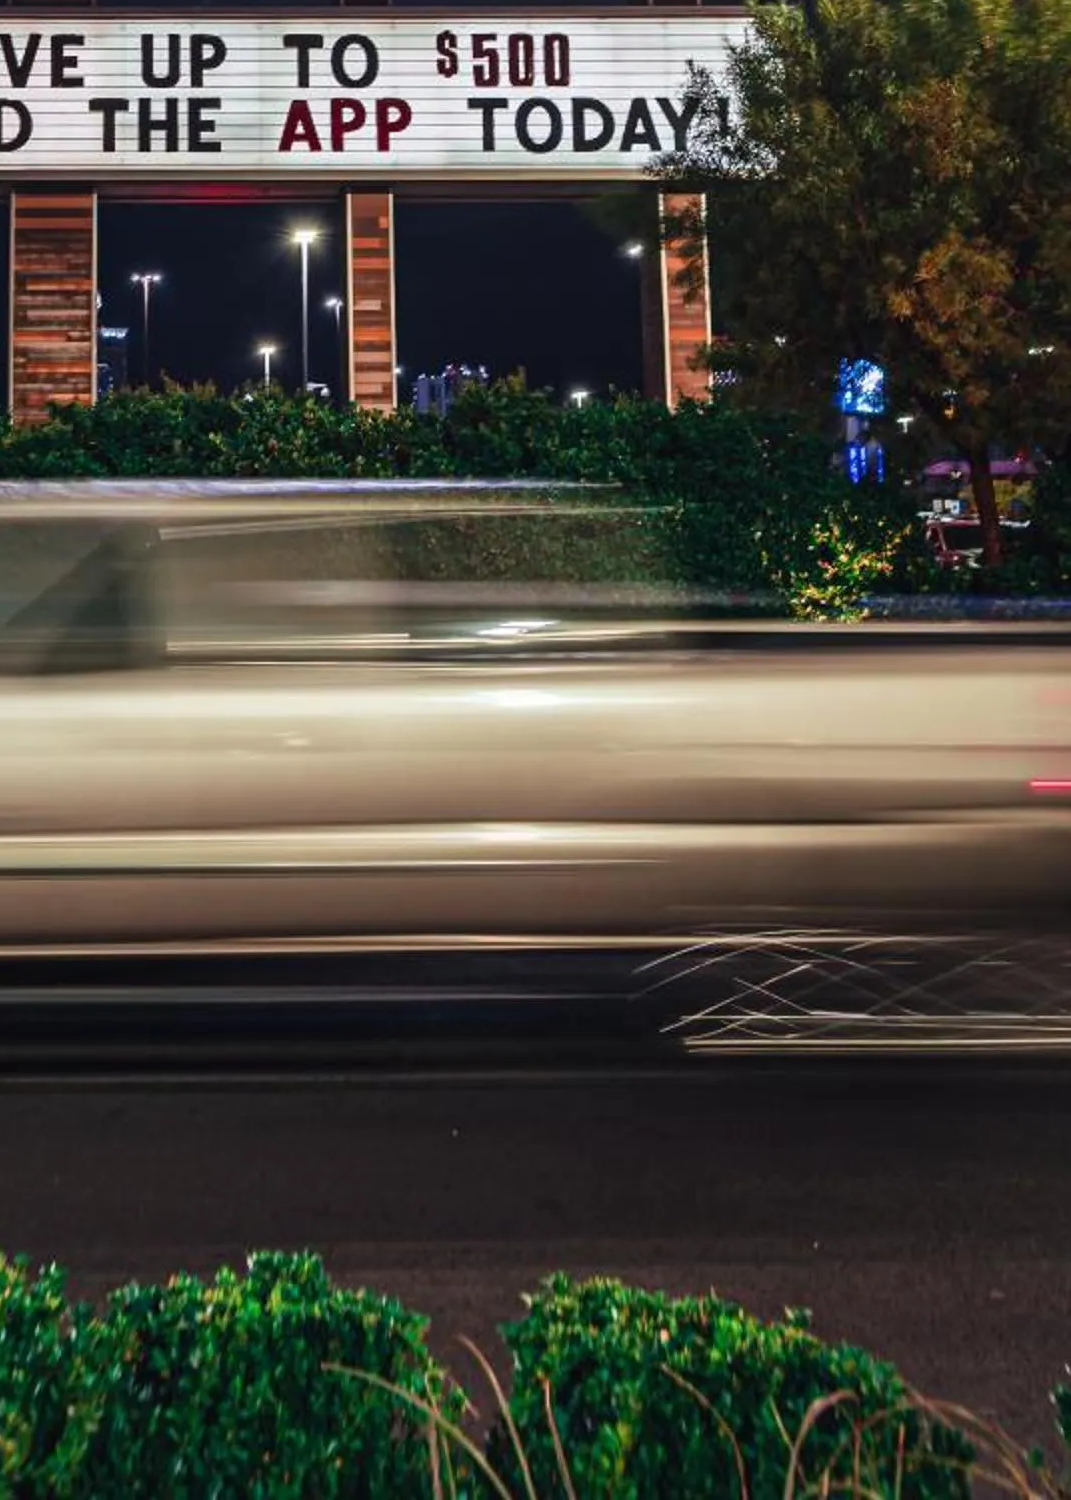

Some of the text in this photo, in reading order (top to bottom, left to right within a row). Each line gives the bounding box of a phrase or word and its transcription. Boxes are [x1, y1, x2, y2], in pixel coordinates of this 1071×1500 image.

[141, 33, 227, 89] UP
[283, 34, 379, 88] TO
[436, 30, 570, 87] $500
[88, 97, 222, 153] THE
[279, 97, 412, 152] APP
